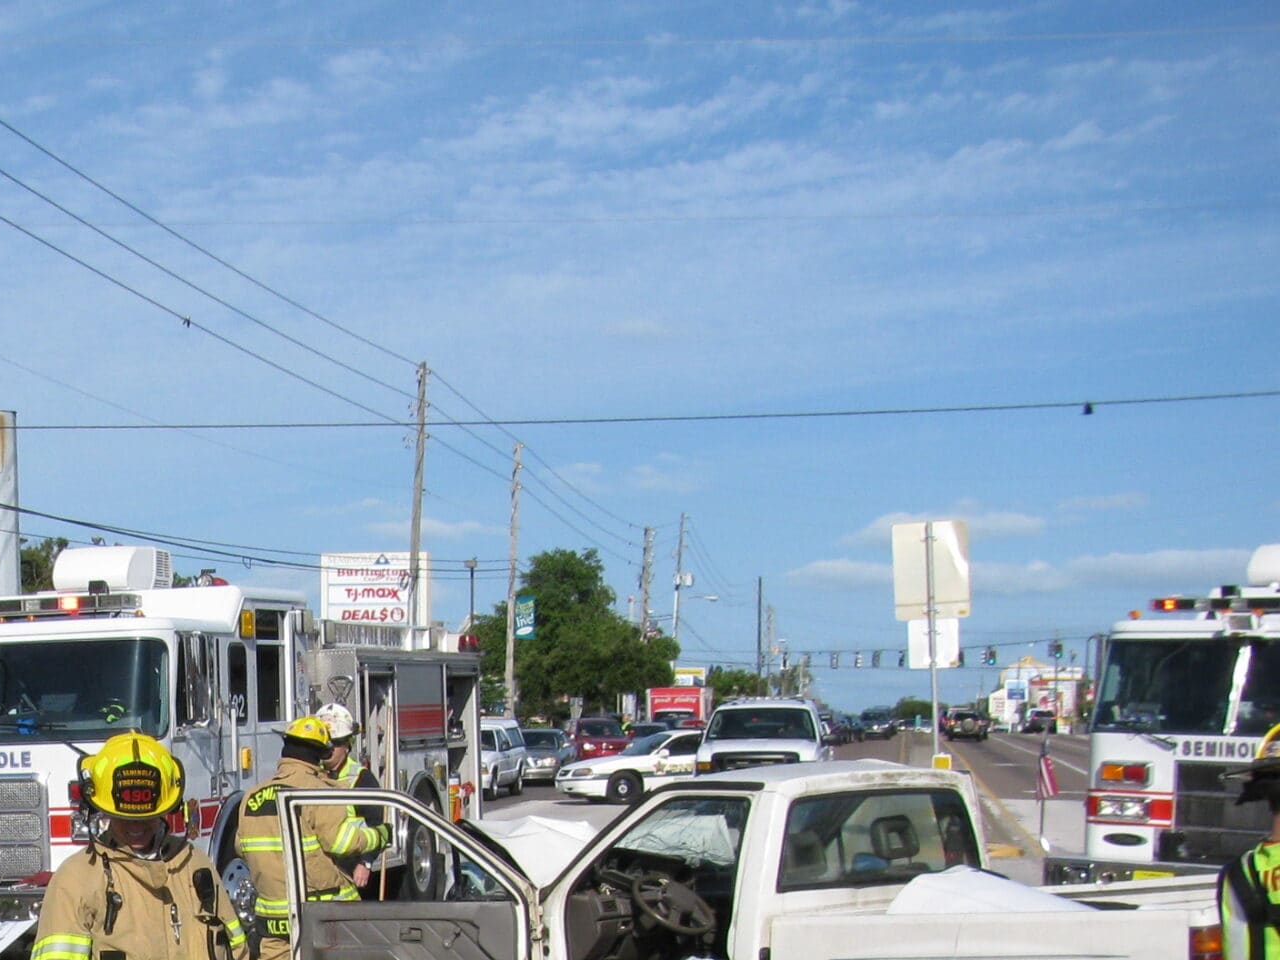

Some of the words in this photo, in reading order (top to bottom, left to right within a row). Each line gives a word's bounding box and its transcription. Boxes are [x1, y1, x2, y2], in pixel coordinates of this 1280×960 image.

[341, 607, 388, 622] DEAL$
[1182, 741, 1257, 758] SEMINOL
[121, 788, 152, 802] 490
[247, 785, 280, 812] SEMI
